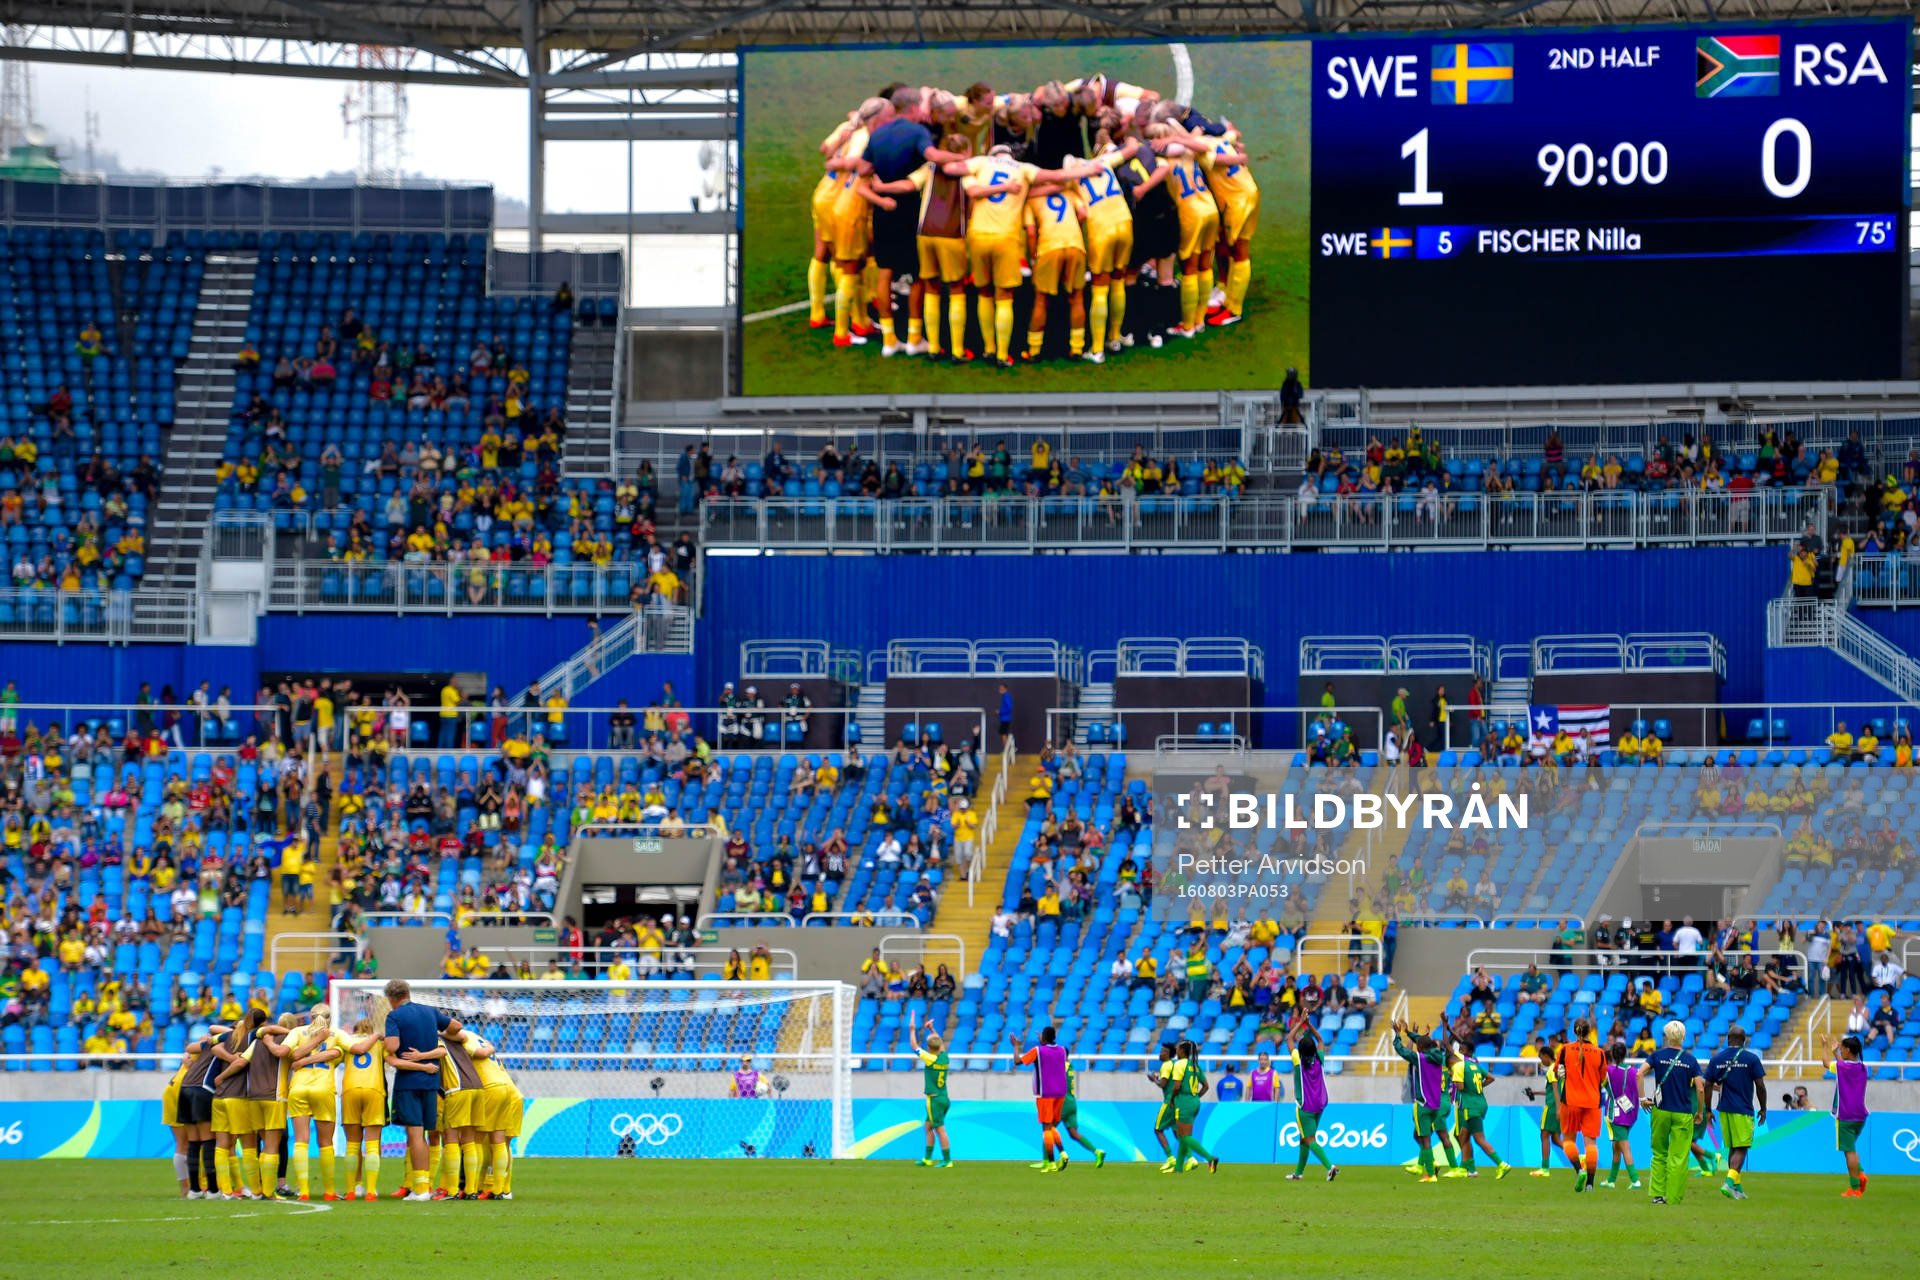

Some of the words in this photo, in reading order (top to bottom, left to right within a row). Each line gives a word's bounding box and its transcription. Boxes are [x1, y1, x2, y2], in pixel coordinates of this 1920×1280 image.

[1327, 55, 1418, 99] SWE
[1548, 47, 1594, 70] 2ND
[1600, 46, 1660, 68] HALF
[1793, 41, 1889, 87] RSA
[1398, 126, 1443, 206] 1
[1537, 140, 1669, 187] 90:00
[1761, 117, 1812, 199] 0
[987, 170, 1009, 203] 5
[1046, 192, 1068, 223] 9
[1079, 167, 1121, 207] 12
[1321, 232, 1368, 256] SWE
[1438, 231, 1452, 254] 5
[1478, 229, 1580, 253] FISCHER
[1586, 227, 1641, 251] Nilla
[1855, 221, 1892, 245] 75'
